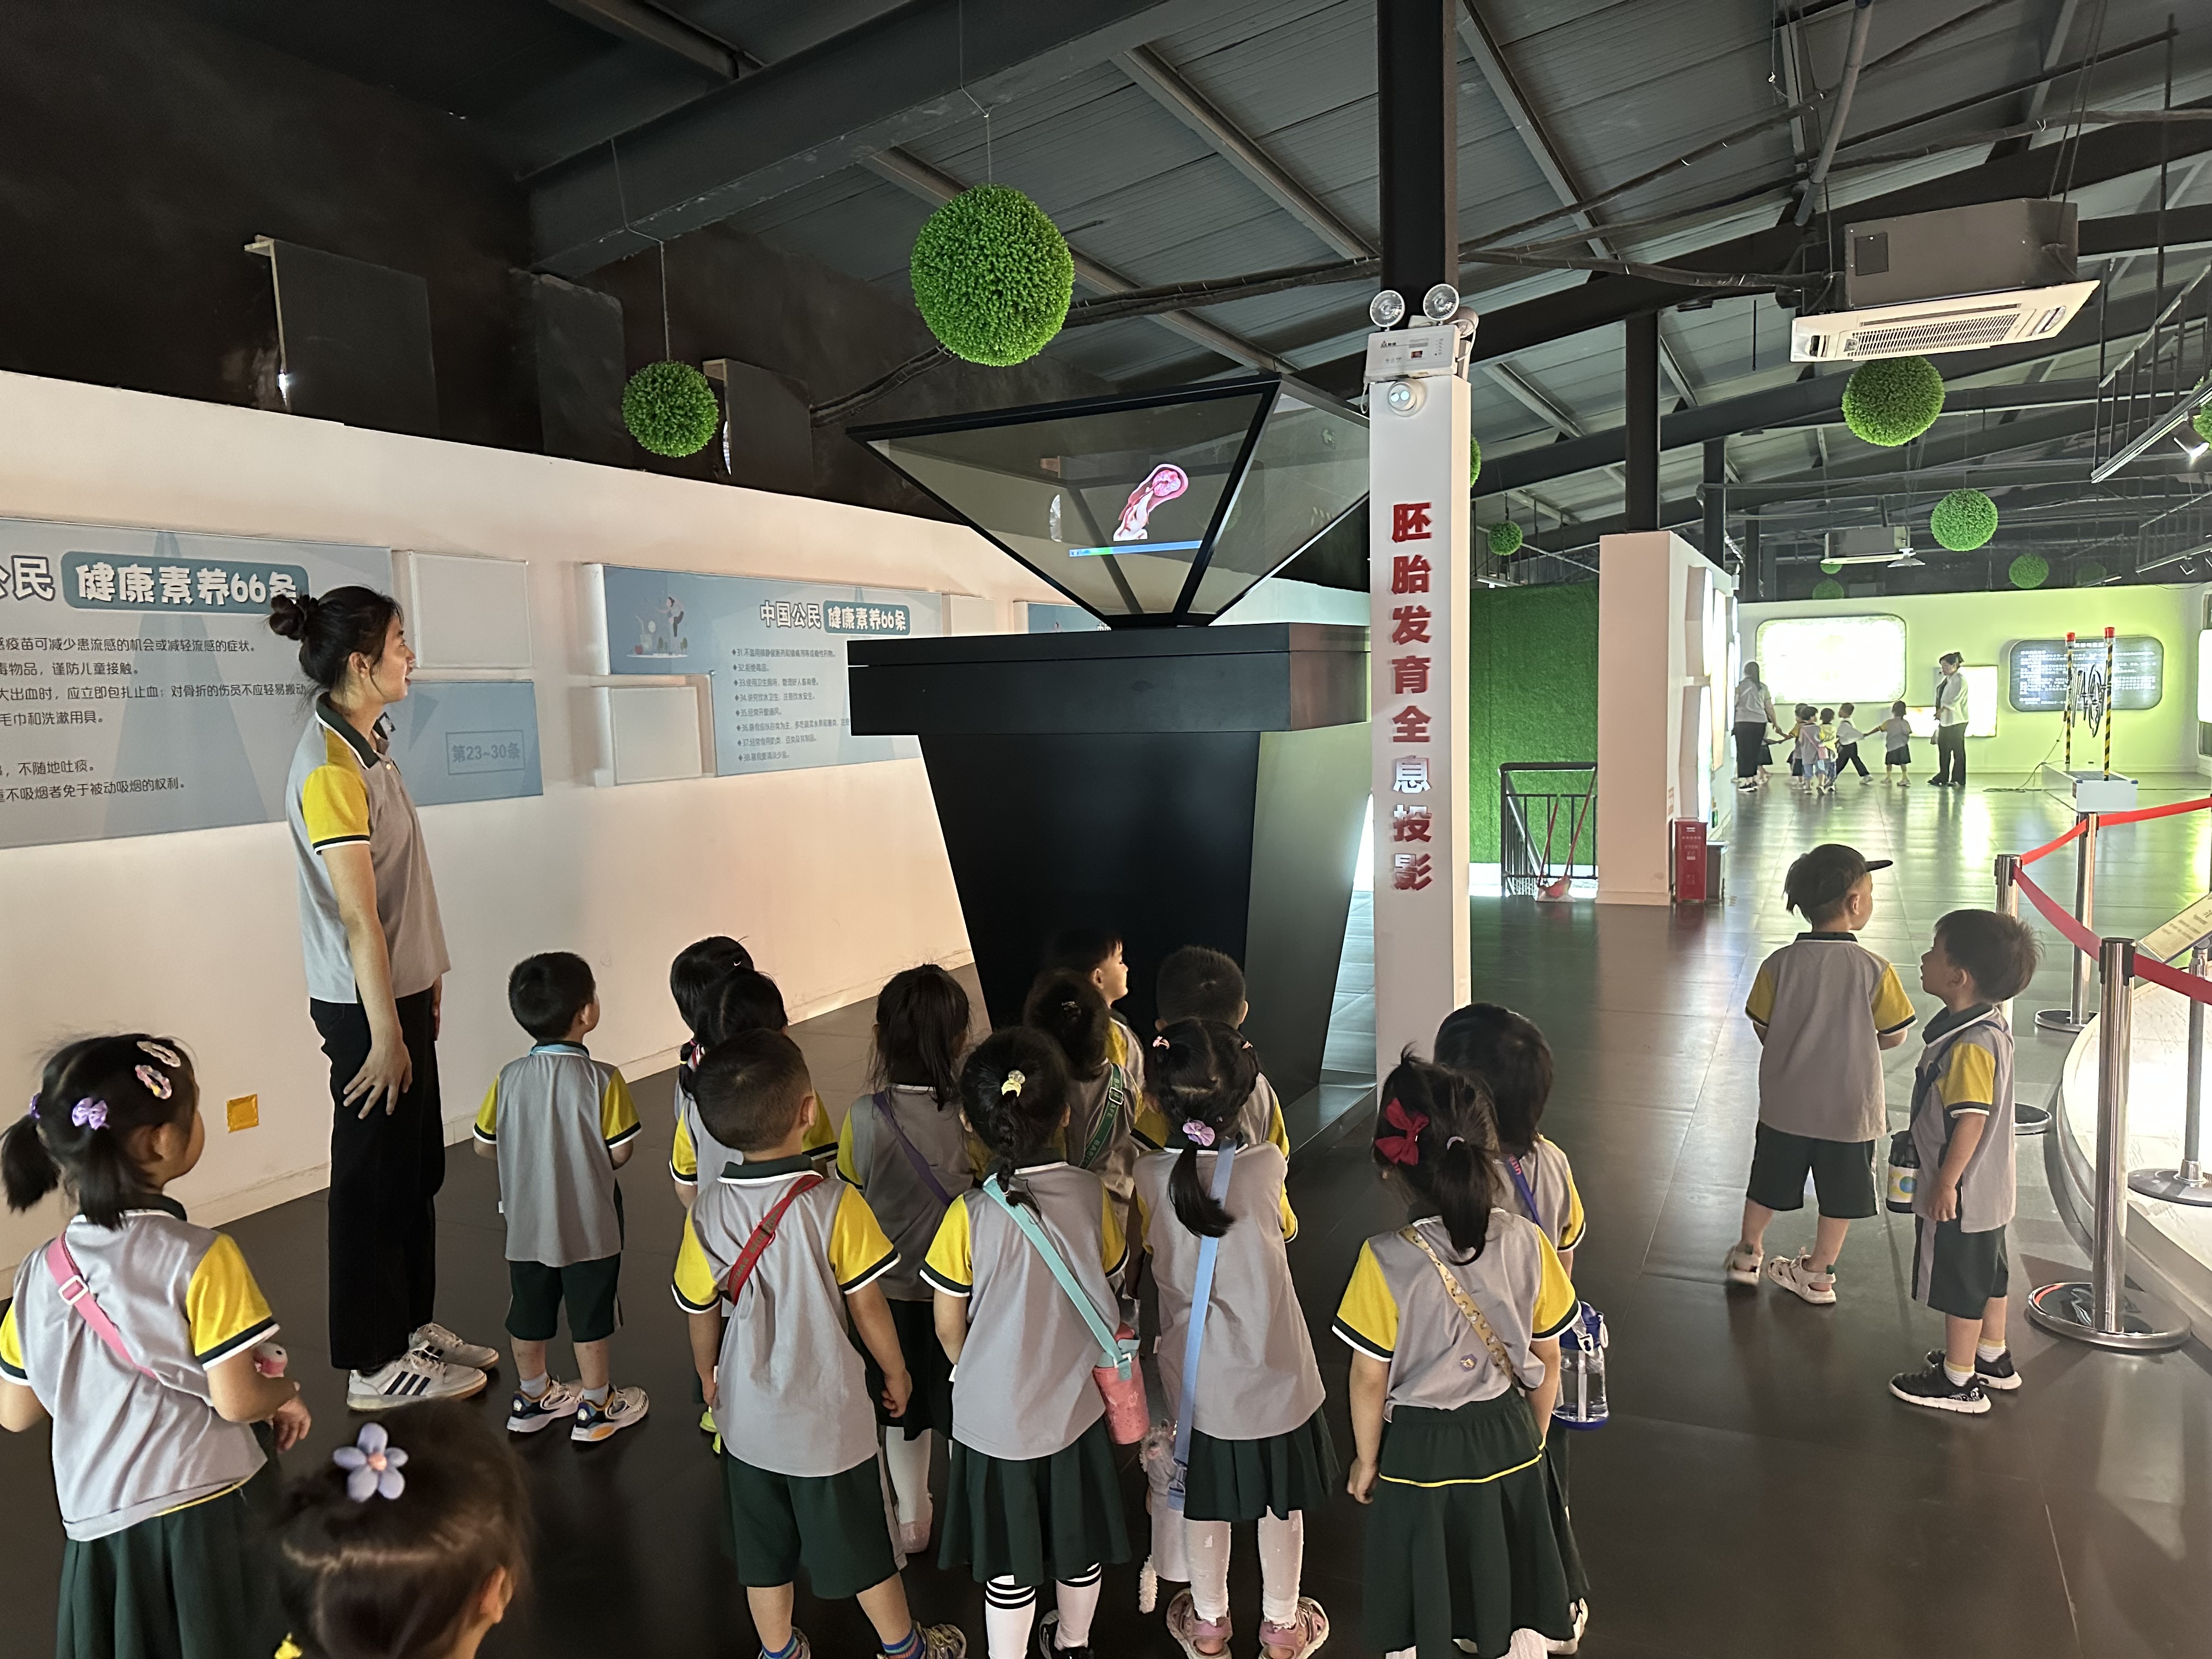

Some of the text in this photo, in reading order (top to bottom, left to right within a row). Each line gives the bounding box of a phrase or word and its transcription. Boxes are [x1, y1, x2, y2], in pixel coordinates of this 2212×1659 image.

[0, 555, 297, 604] 民 健康素养66条
[760, 600, 906, 631] 中国公民 健康素养66条
[1392, 502, 1433, 891] 胚胎发育全息投影
[0, 710, 103, 726] 毛巾和洗漱用具。
[452, 741, 520, 763] 第23~30条
[0, 759, 94, 777] ，不随地吐痰。
[0, 777, 185, 803] 不吸烟者免于被动吸烟的权利。
